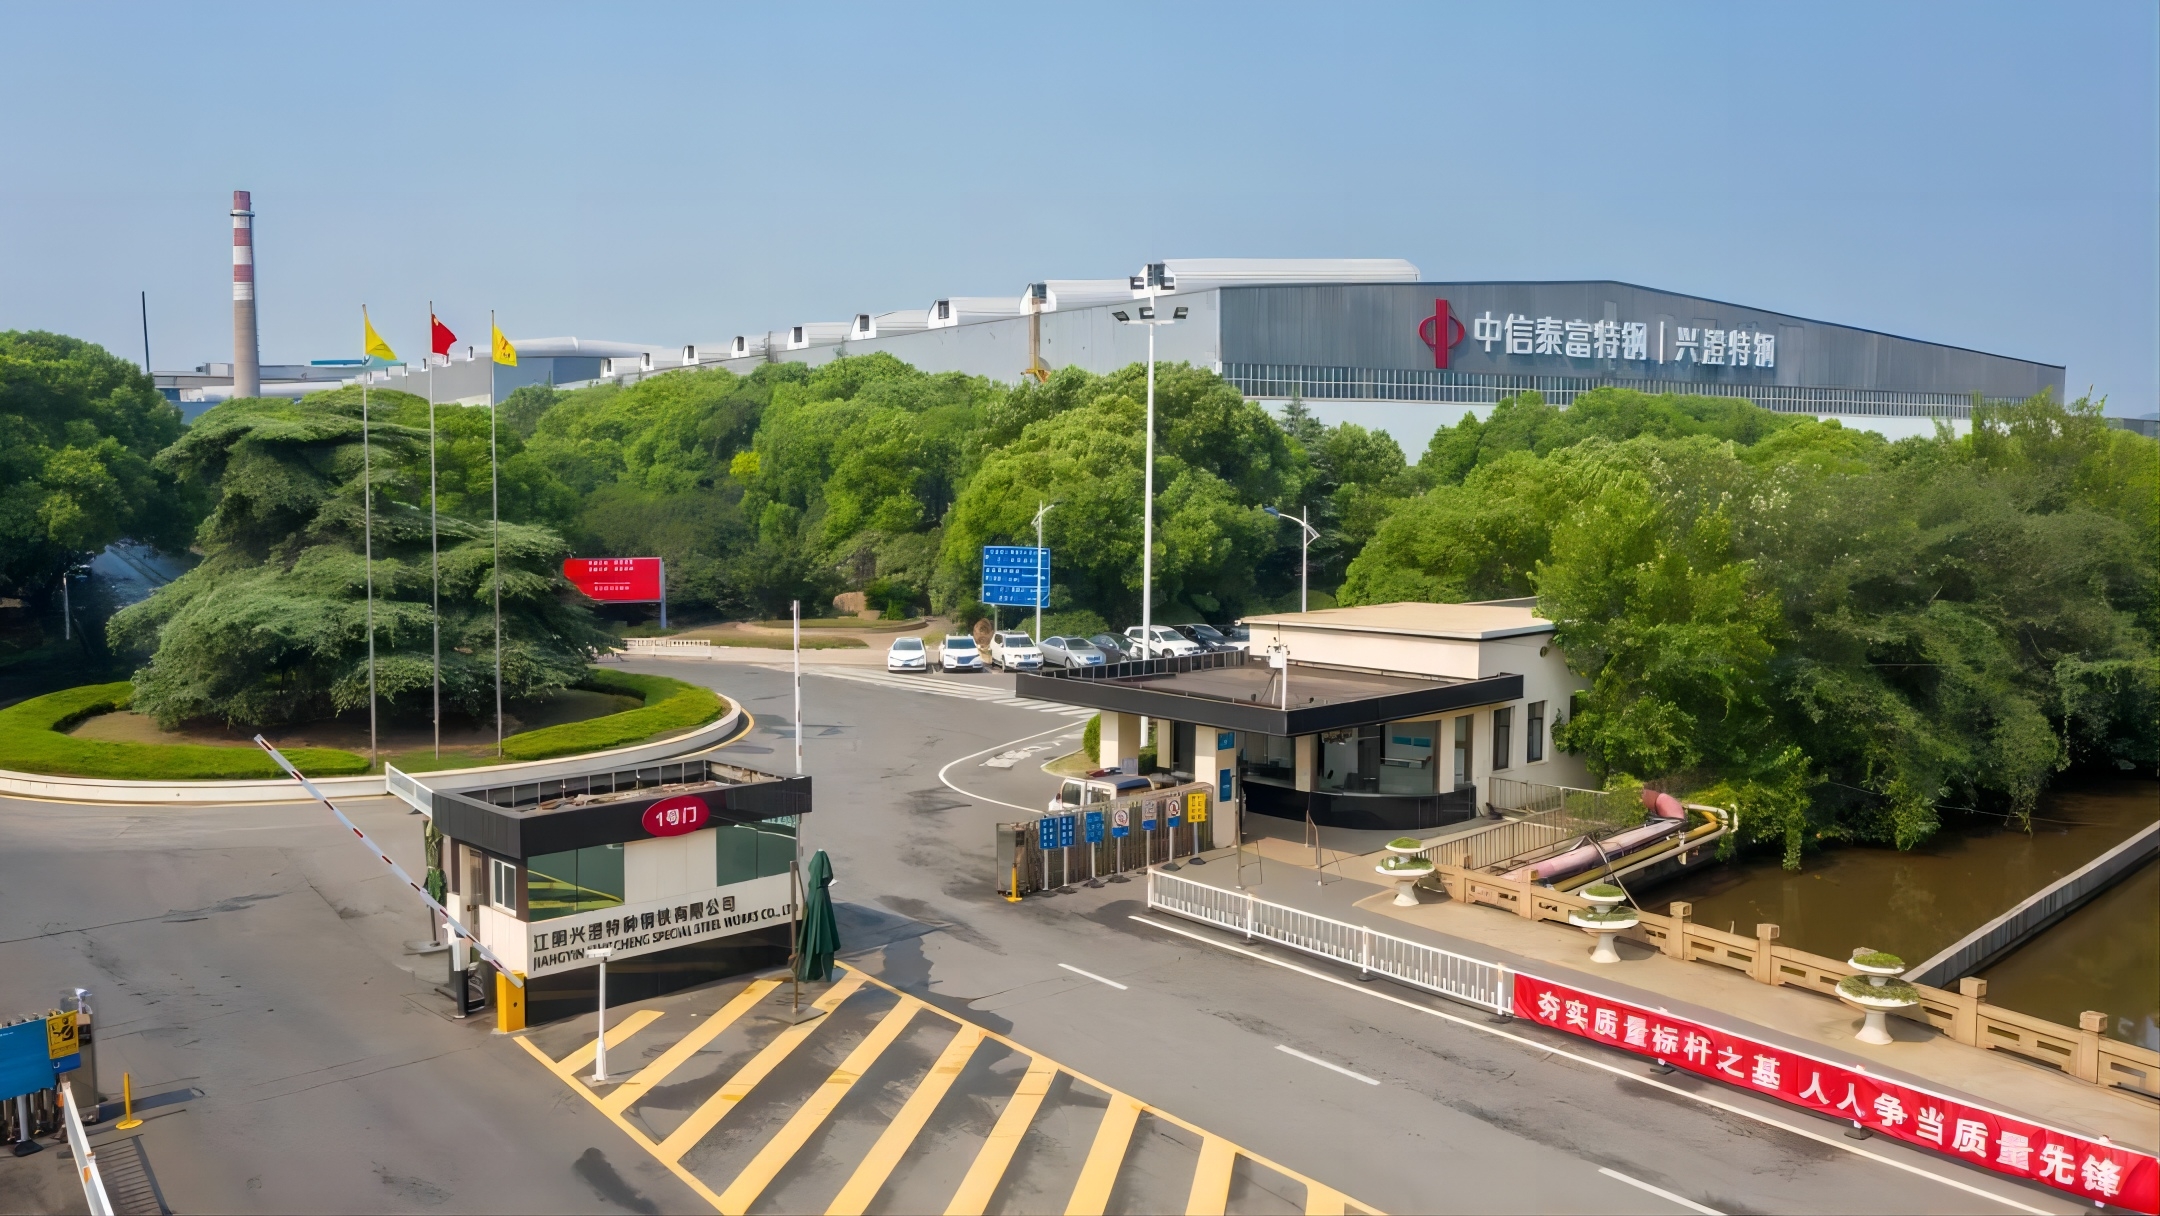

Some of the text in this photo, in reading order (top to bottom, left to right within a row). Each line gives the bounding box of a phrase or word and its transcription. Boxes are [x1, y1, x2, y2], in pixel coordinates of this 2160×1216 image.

[1473, 311, 1648, 360] 中信泰富特钢
[1537, 990, 2123, 1198] 夯实质量标杆之基 人人争当质量先锋
